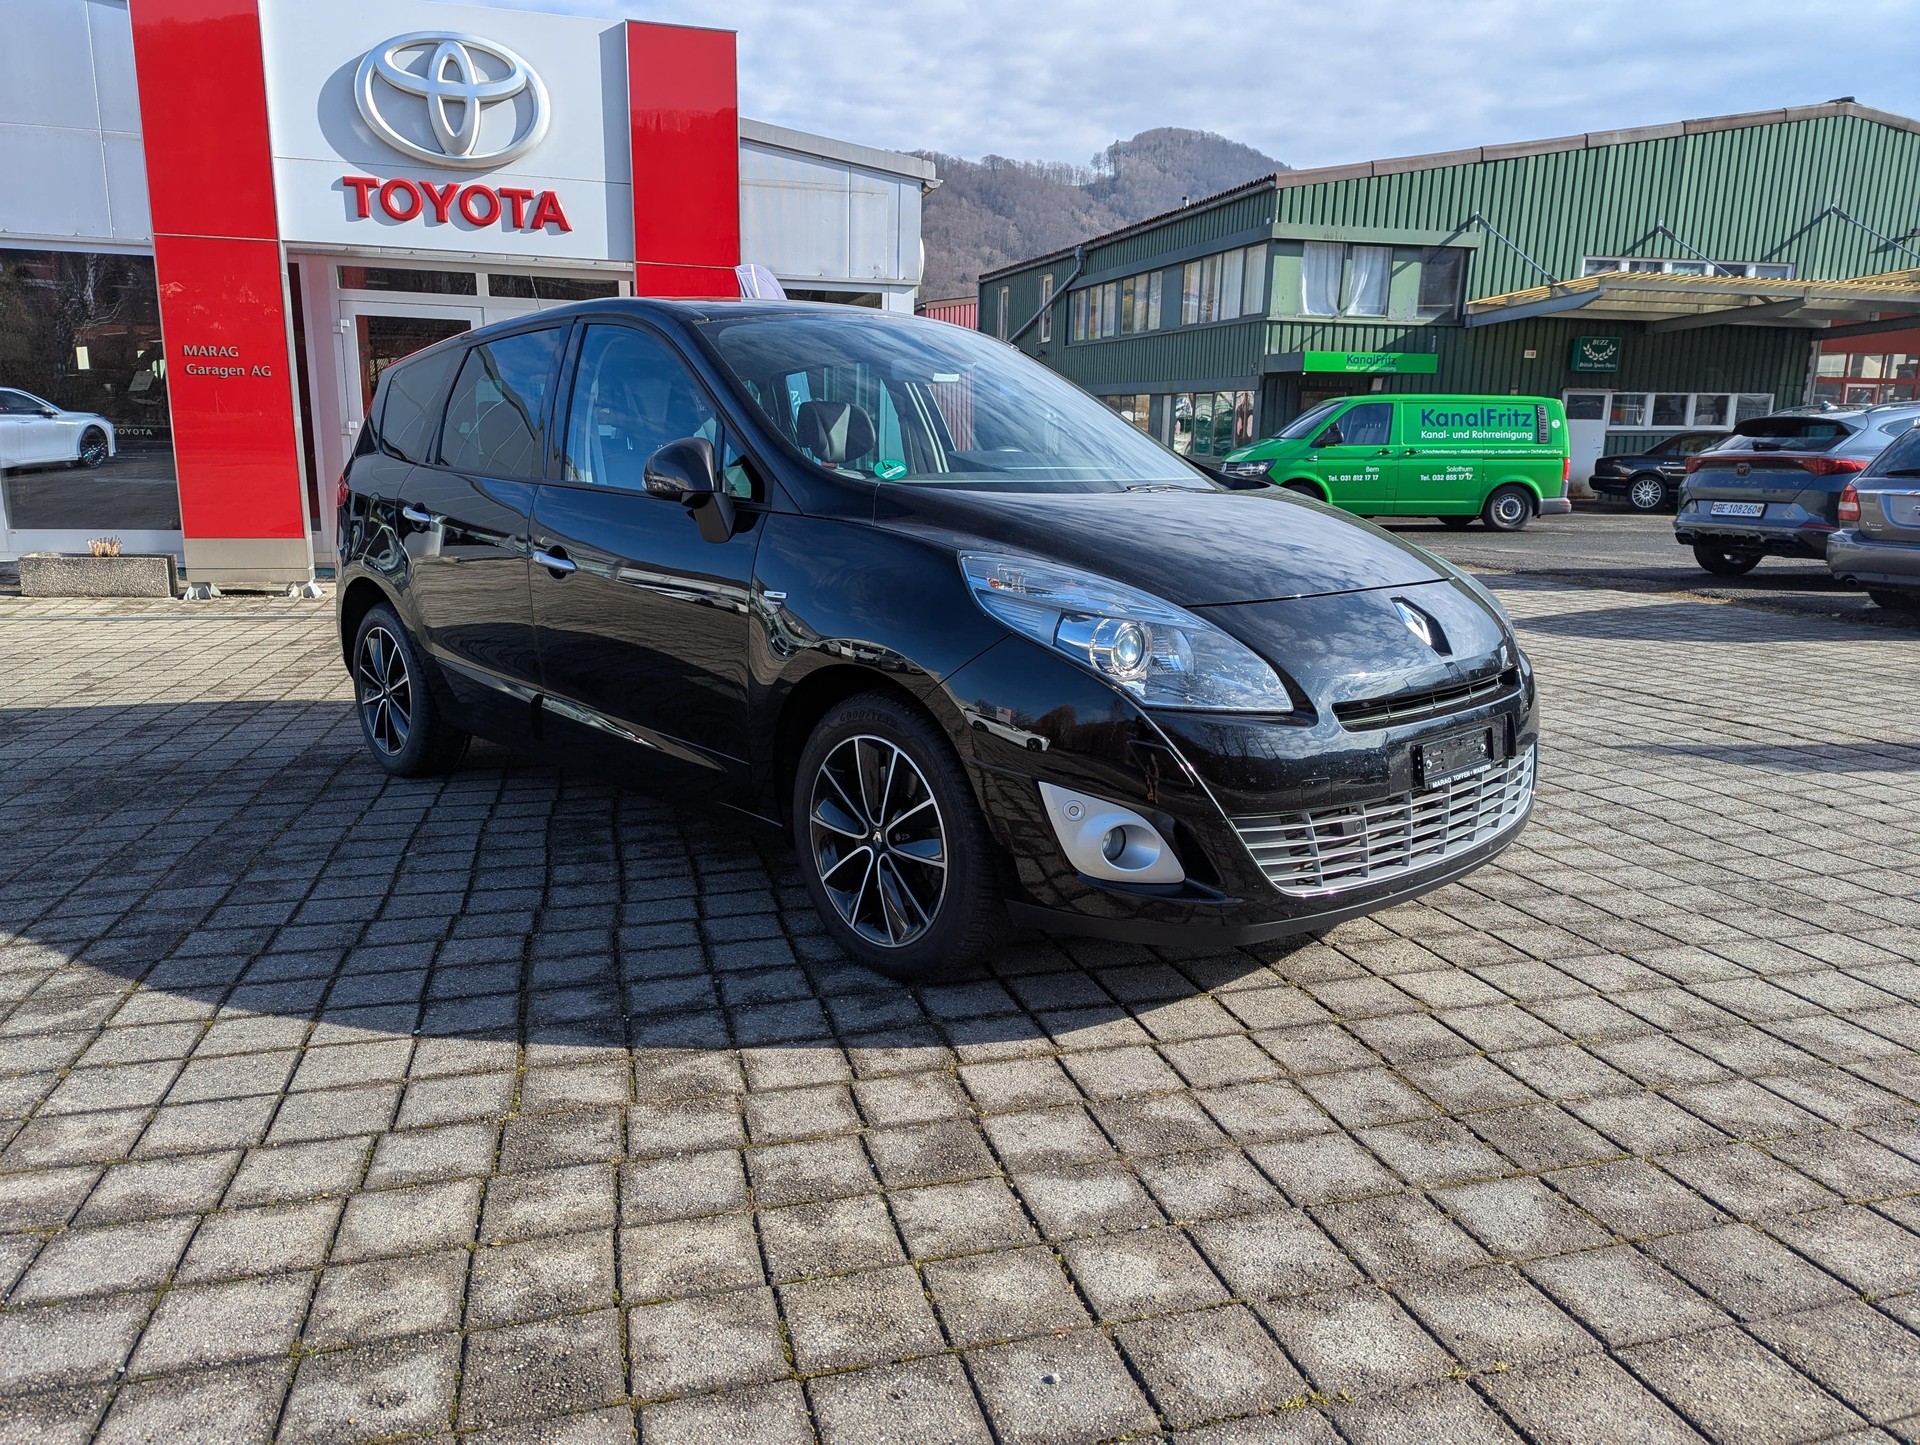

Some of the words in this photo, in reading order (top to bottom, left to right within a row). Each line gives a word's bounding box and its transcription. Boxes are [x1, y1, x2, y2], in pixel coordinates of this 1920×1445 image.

[343, 176, 573, 232] TOYOTA
[183, 345, 239, 357] MARAG
[1346, 354, 1397, 365] KanalFritz
[186, 363, 246, 378] Garagen
[251, 365, 272, 377] AG
[1421, 407, 1533, 428] KanalFritz
[1421, 430, 1450, 439] Kanal-
[1452, 431, 1470, 439] und
[1472, 431, 1533, 441] Rohrreinigung
[1432, 777, 1452, 788] MARAG
[1453, 773, 1470, 781] TOFFEN
